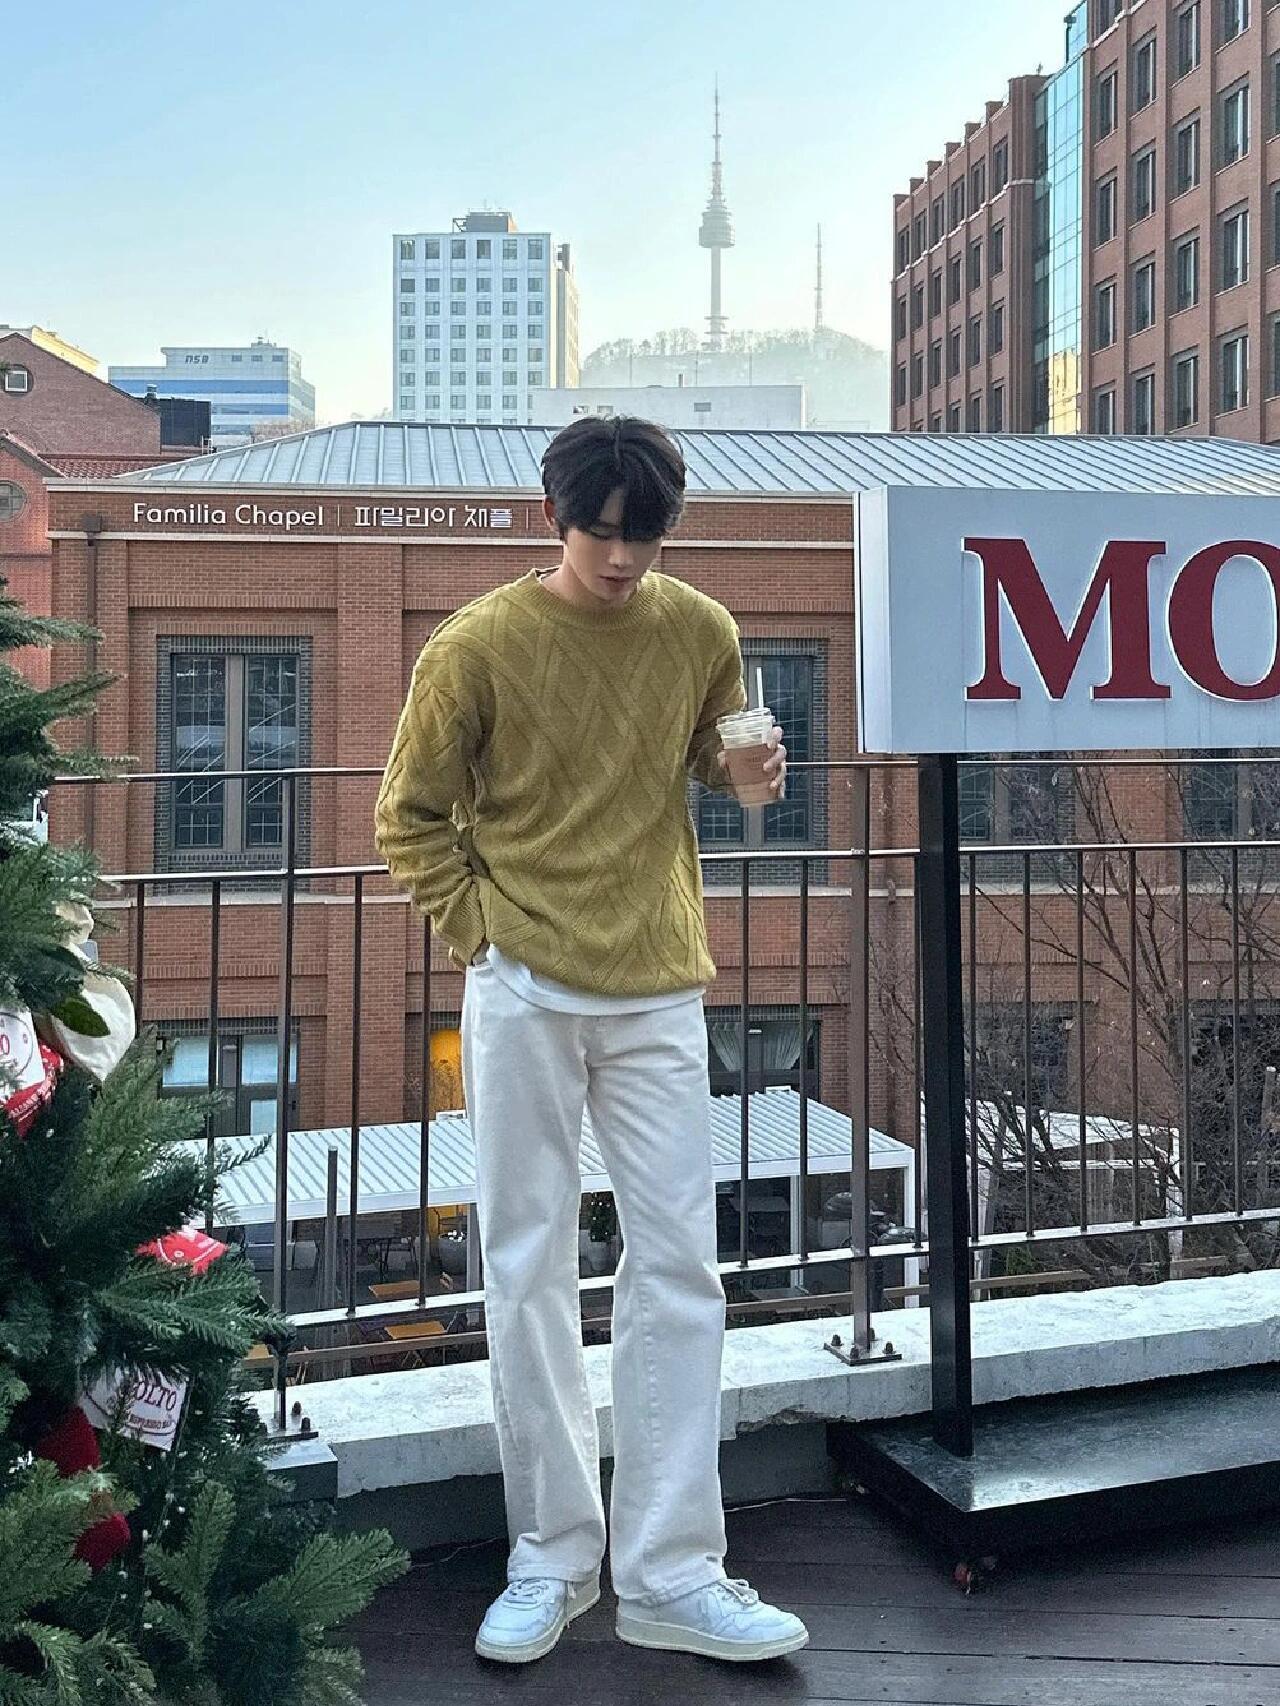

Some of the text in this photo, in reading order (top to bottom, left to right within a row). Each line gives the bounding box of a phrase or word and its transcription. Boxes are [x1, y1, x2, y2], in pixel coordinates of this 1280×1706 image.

[133, 502, 323, 531] Familia Chapel
[354, 505, 513, 528] 파밀리아 채플
[961, 536, 1280, 702] MO
[130, 1380, 177, 1411] OLTO
